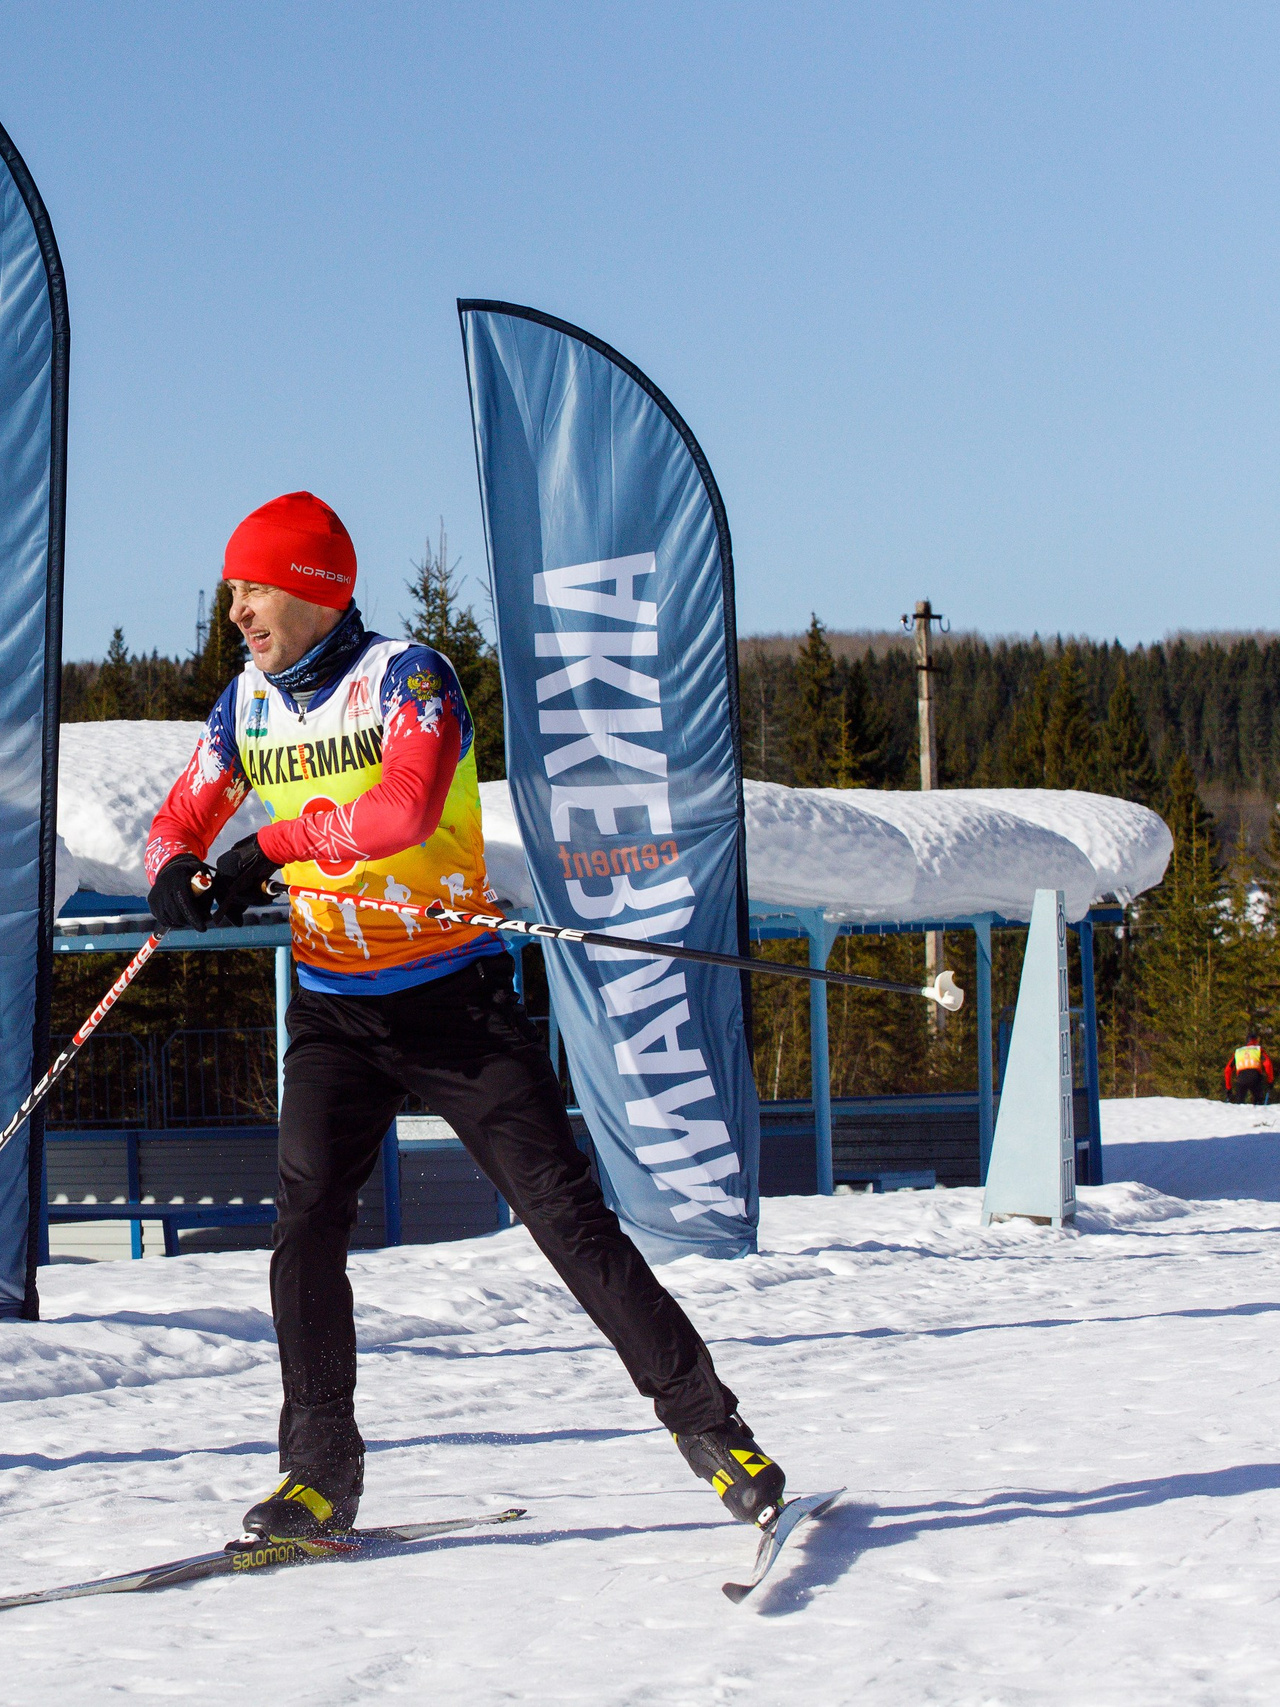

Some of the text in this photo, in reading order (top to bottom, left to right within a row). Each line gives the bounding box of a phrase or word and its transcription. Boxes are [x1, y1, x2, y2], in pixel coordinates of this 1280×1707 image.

[290, 562, 352, 585] NORDSKI
[298, 743, 309, 780] cement
[1057, 903, 1075, 1207] ФИНИШ
